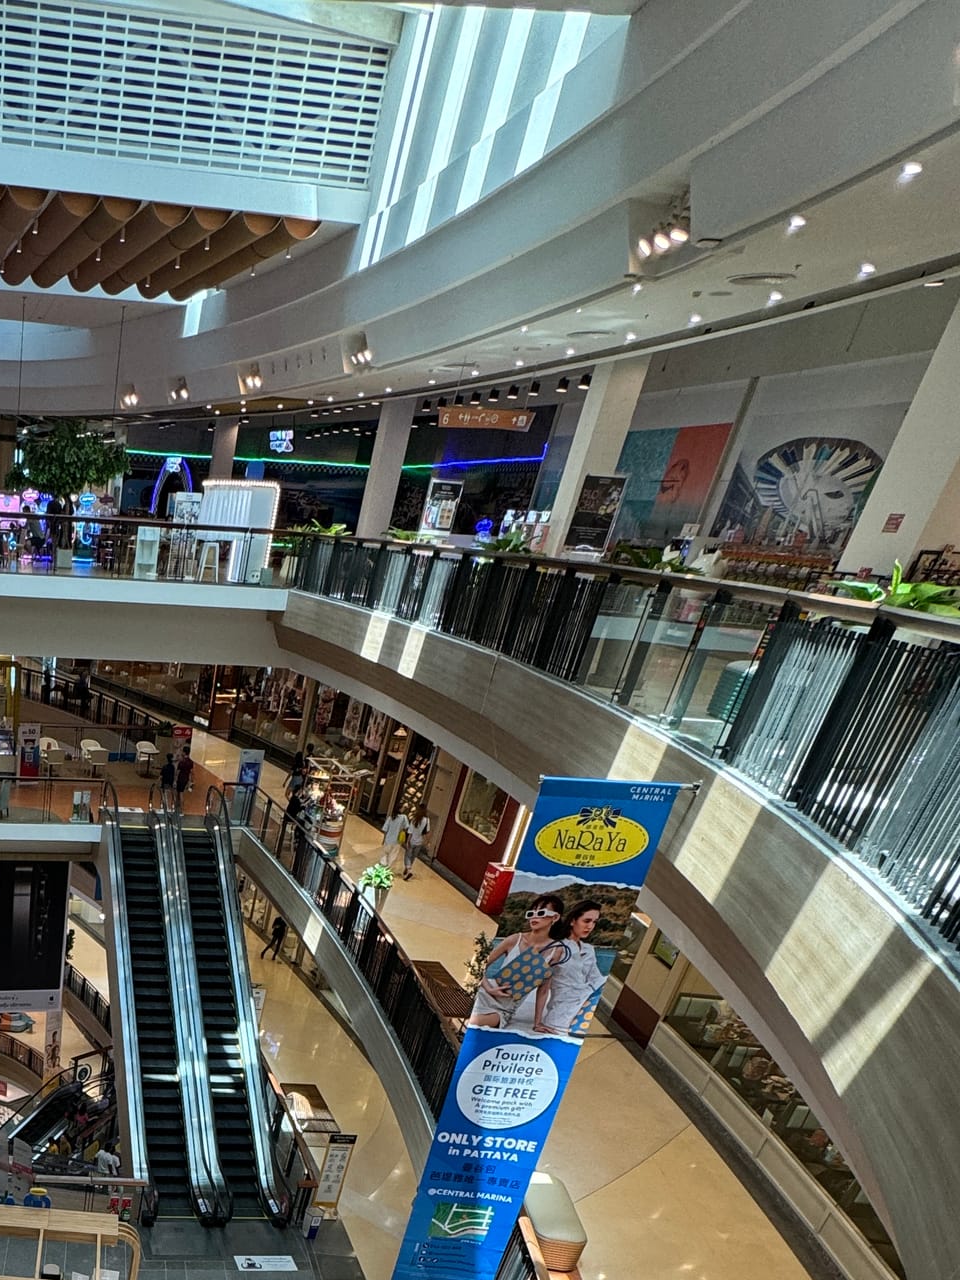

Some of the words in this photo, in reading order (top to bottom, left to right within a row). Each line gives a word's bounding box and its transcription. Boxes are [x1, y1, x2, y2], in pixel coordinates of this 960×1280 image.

[442, 414, 451, 425] 6
[630, 786, 673, 795] CENTRAL
[631, 794, 665, 802] MARINA
[552, 828, 628, 852] NaRaYa
[495, 1048, 541, 1062] Tourist
[482, 1060, 544, 1078] Privilege
[472, 1084, 502, 1097] GET
[503, 1087, 539, 1100] FREE
[471, 1097, 501, 1105] Welcome
[437, 1131, 483, 1146] ONLY
[483, 1136, 538, 1153] STORE
[448, 1146, 460, 1156] in
[462, 1148, 519, 1162] PATTAYA
[427, 1188, 475, 1199] @CENTRAL
[476, 1192, 513, 1204] MARINA
